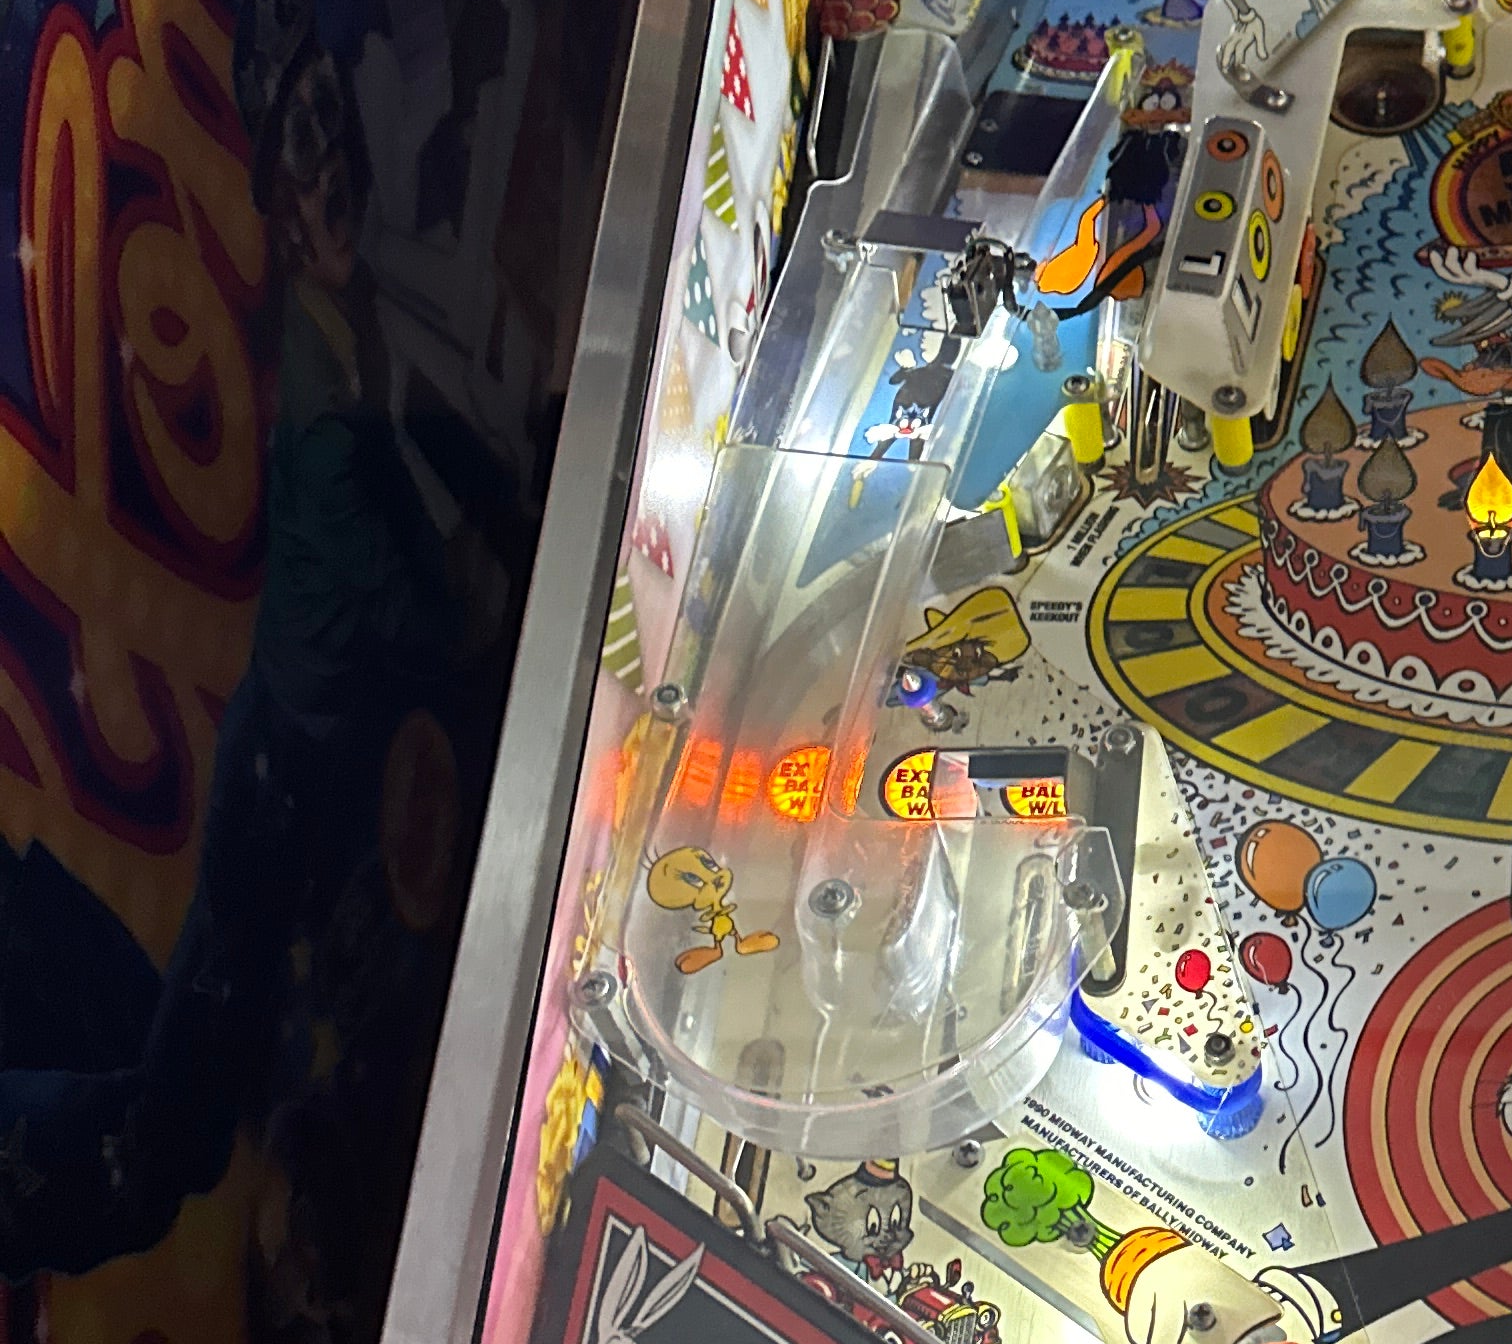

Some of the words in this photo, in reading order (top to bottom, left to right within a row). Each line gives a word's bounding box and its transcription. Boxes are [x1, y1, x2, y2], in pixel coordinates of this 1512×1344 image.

[1030, 601, 1083, 611] SPEEDY'S
[896, 768, 931, 783] EXT
[901, 786, 930, 799] BA
[1022, 1096, 1050, 1117] 1990
[1048, 1113, 1098, 1149] MIDWAY
[1094, 1144, 1197, 1221] MANUFACTURING
[1194, 1214, 1257, 1260] COMPANY
[1020, 1114, 1124, 1189] MANUFACTURERS
[1122, 1185, 1143, 1201] OF
[1139, 1196, 1230, 1260] BALLY/MIDWAY
